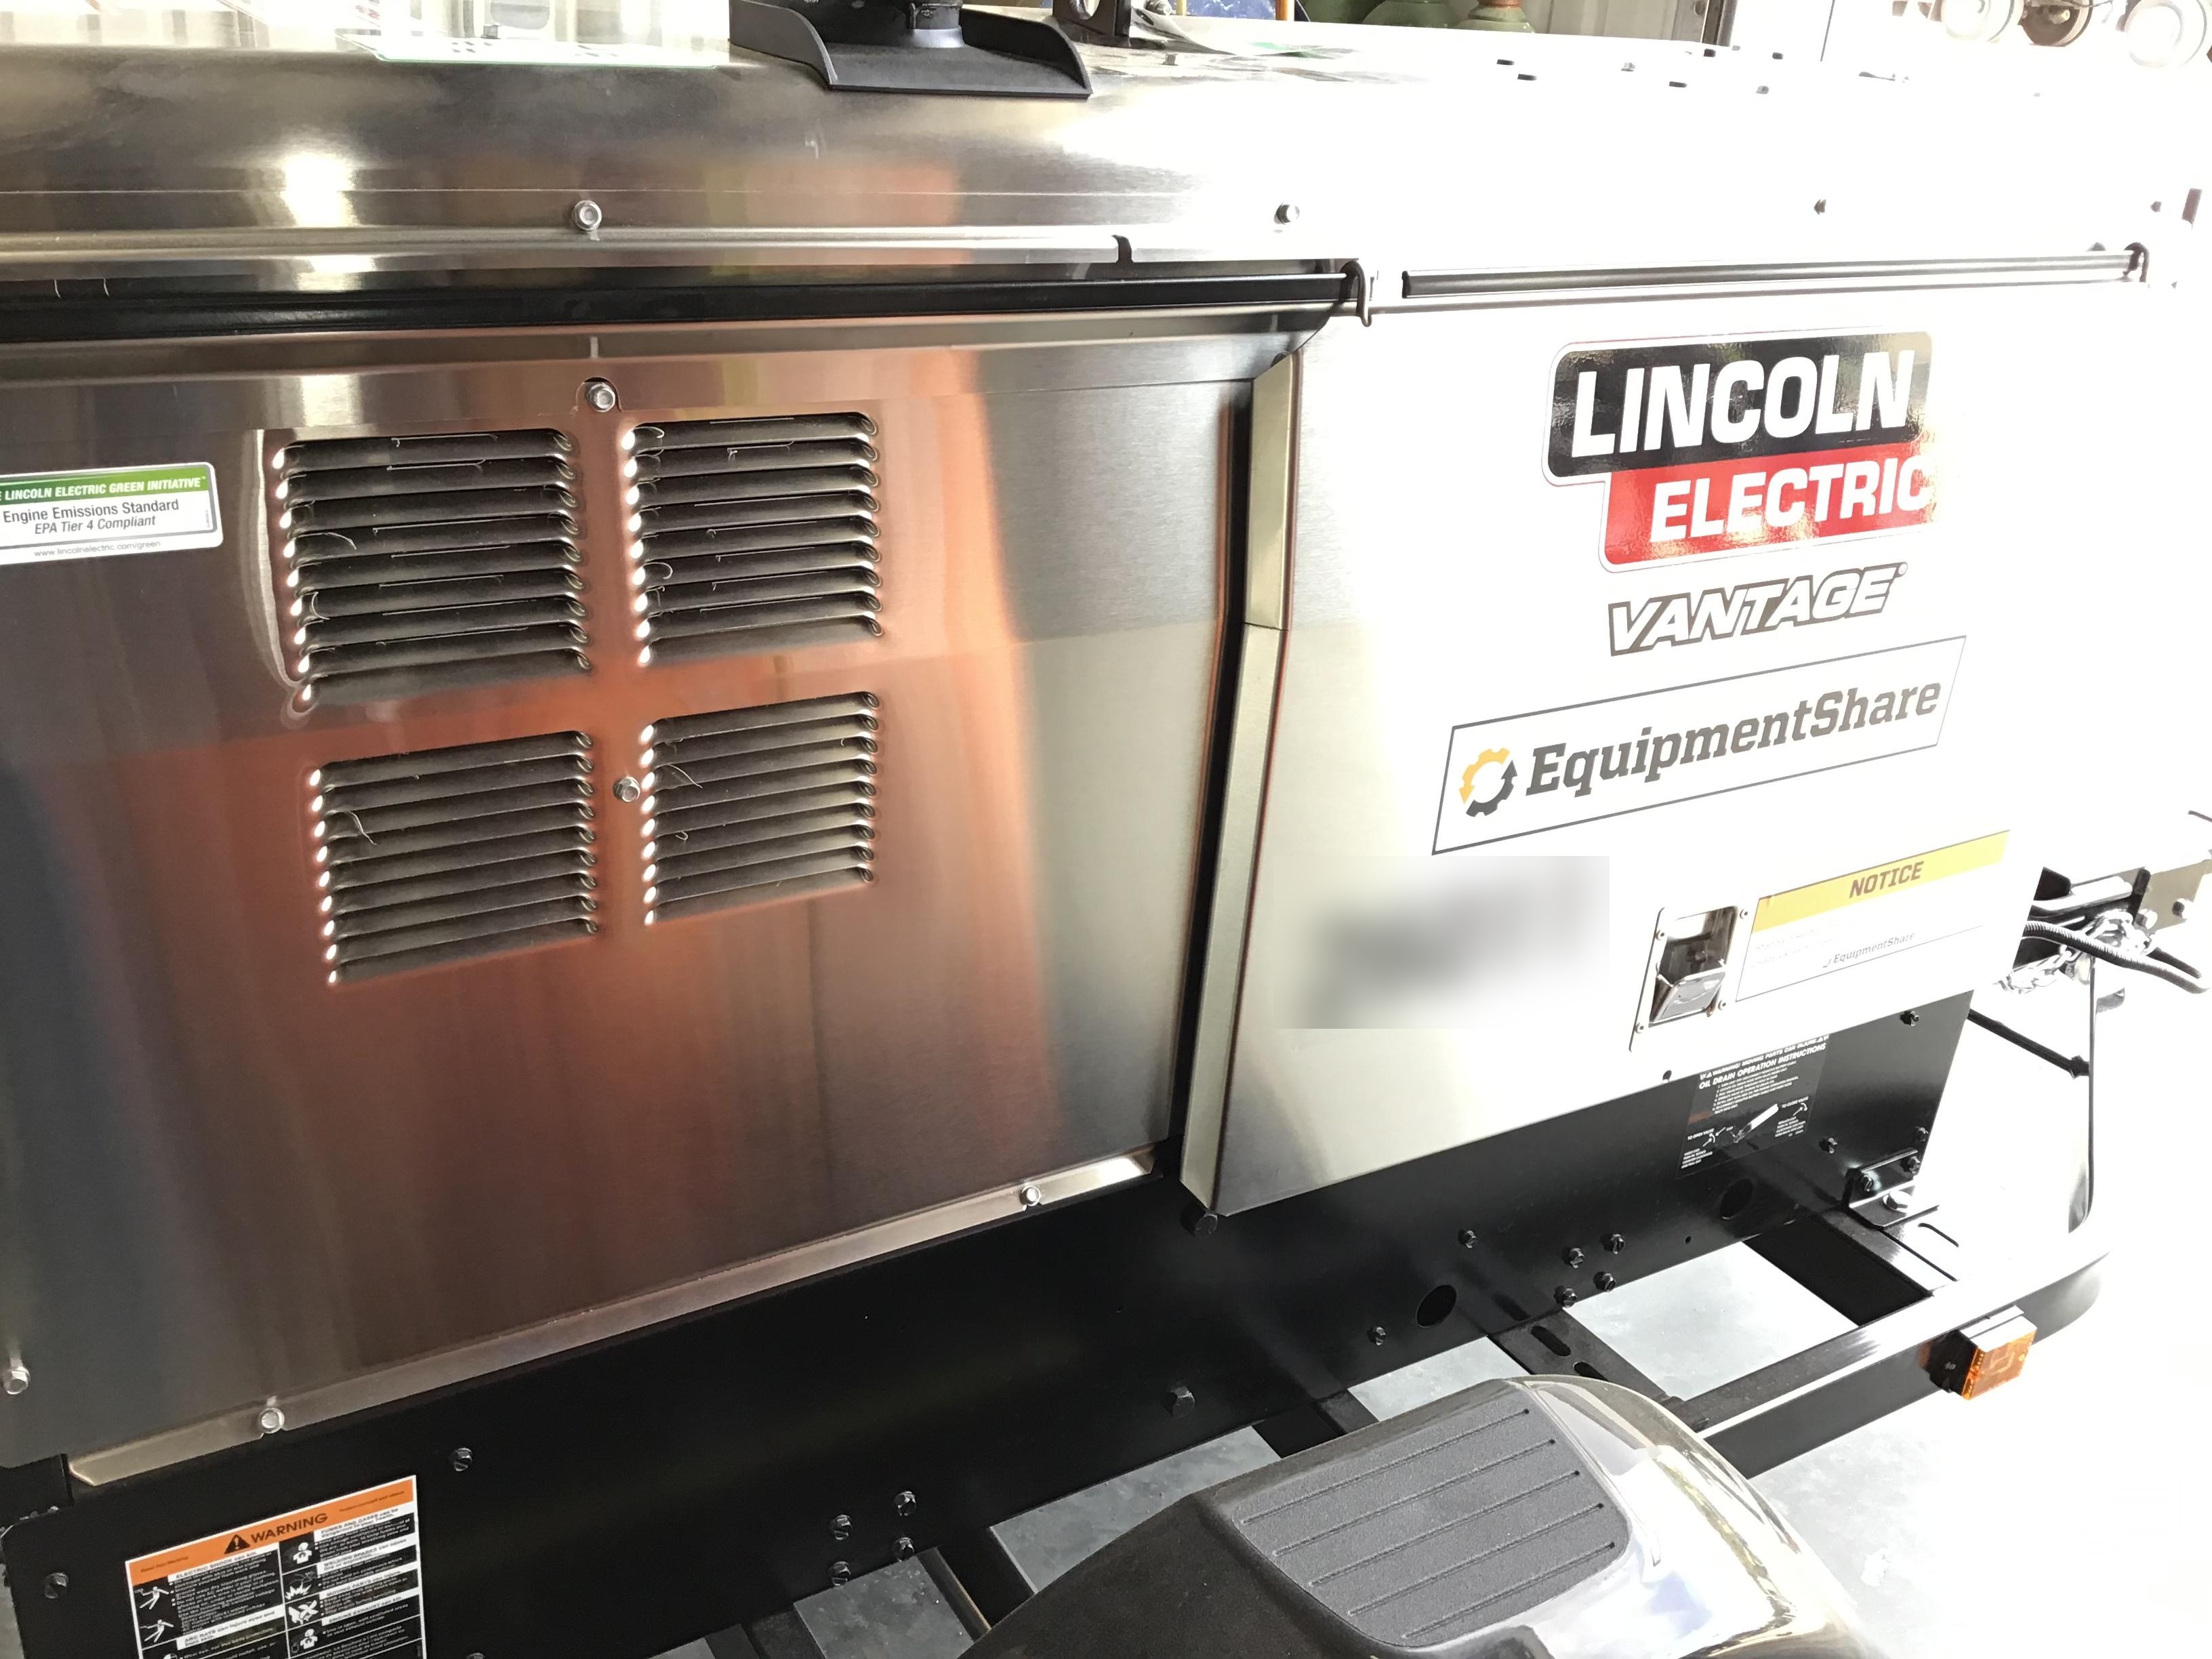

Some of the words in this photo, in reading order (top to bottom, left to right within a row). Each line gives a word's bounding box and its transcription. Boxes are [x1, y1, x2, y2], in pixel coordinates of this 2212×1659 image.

[1571, 349, 1915, 458] LINCOLN
[5, 487, 52, 501] LINCOLN
[55, 483, 106, 497] ELECTRIC
[109, 480, 144, 493] GREEN
[147, 477, 201, 491] INITIATIVE
[1650, 455, 1936, 544] ELECTRIC
[3, 508, 48, 524] Engine
[53, 504, 118, 520] Emissions
[122, 499, 180, 514] Standard
[35, 521, 58, 534] EPA
[62, 520, 82, 532] Tier
[87, 520, 94, 530] 4
[97, 515, 156, 531] Compliant
[1525, 682, 1942, 798] EquipmentShare
[1849, 861, 1925, 899] NOTICE
[1832, 933, 1915, 965] EquipmentShare
[1699, 1082, 1711, 1090] OIL
[1713, 1071, 1736, 1086] DRAIN
[1737, 1058, 1777, 1078] OPERATION
[1778, 1042, 1827, 1064] INSTRUCTIONS
[251, 1512, 329, 1544] WARNING
